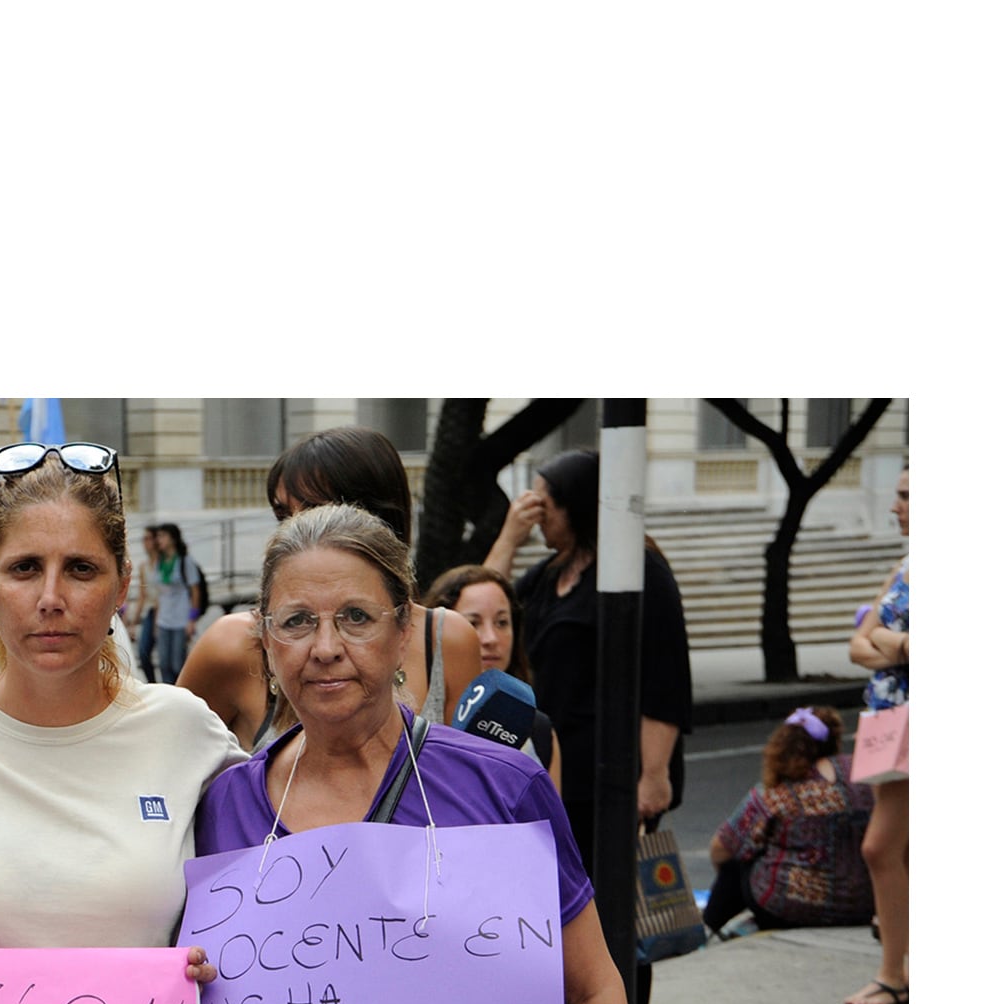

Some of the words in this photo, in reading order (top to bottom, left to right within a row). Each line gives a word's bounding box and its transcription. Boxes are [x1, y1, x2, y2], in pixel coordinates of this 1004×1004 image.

[458, 684, 485, 722] 3
[477, 720, 519, 745] elTres
[145, 800, 164, 814] GM
[191, 845, 348, 935] SOY
[218, 914, 437, 981] OCENTE
[463, 915, 554, 957] EN
